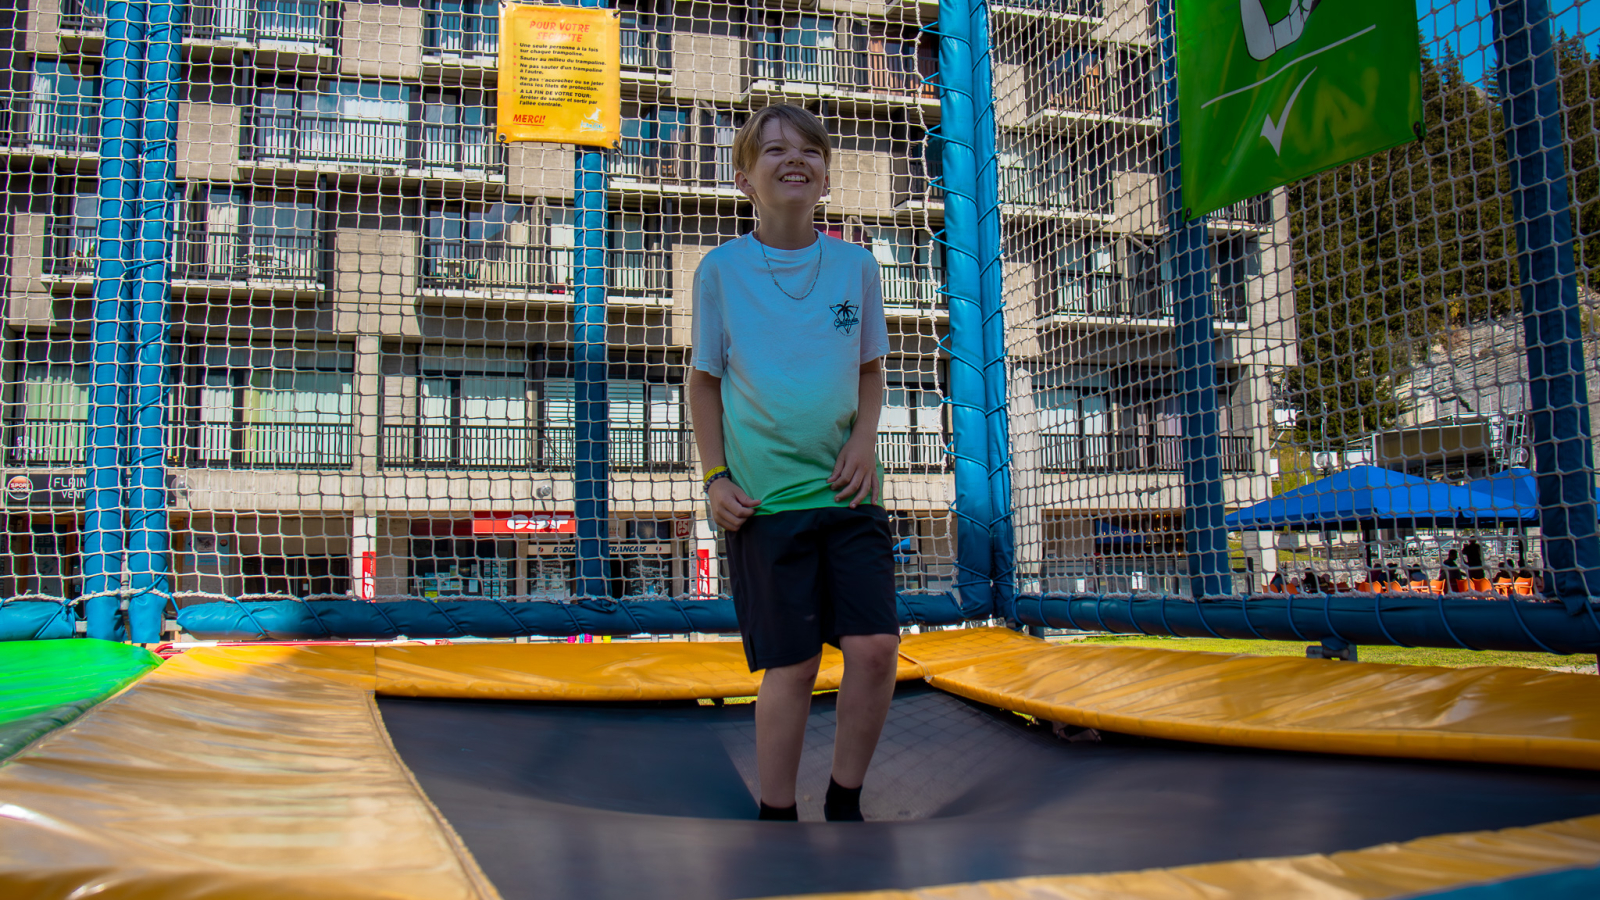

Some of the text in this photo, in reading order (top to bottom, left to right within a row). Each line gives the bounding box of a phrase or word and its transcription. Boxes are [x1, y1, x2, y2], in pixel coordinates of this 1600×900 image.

[529, 21, 590, 33] POUR VOTRE
[575, 58, 607, 66] trampoline.
[573, 65, 603, 73] trampoline
[513, 114, 546, 123] MERCI!
